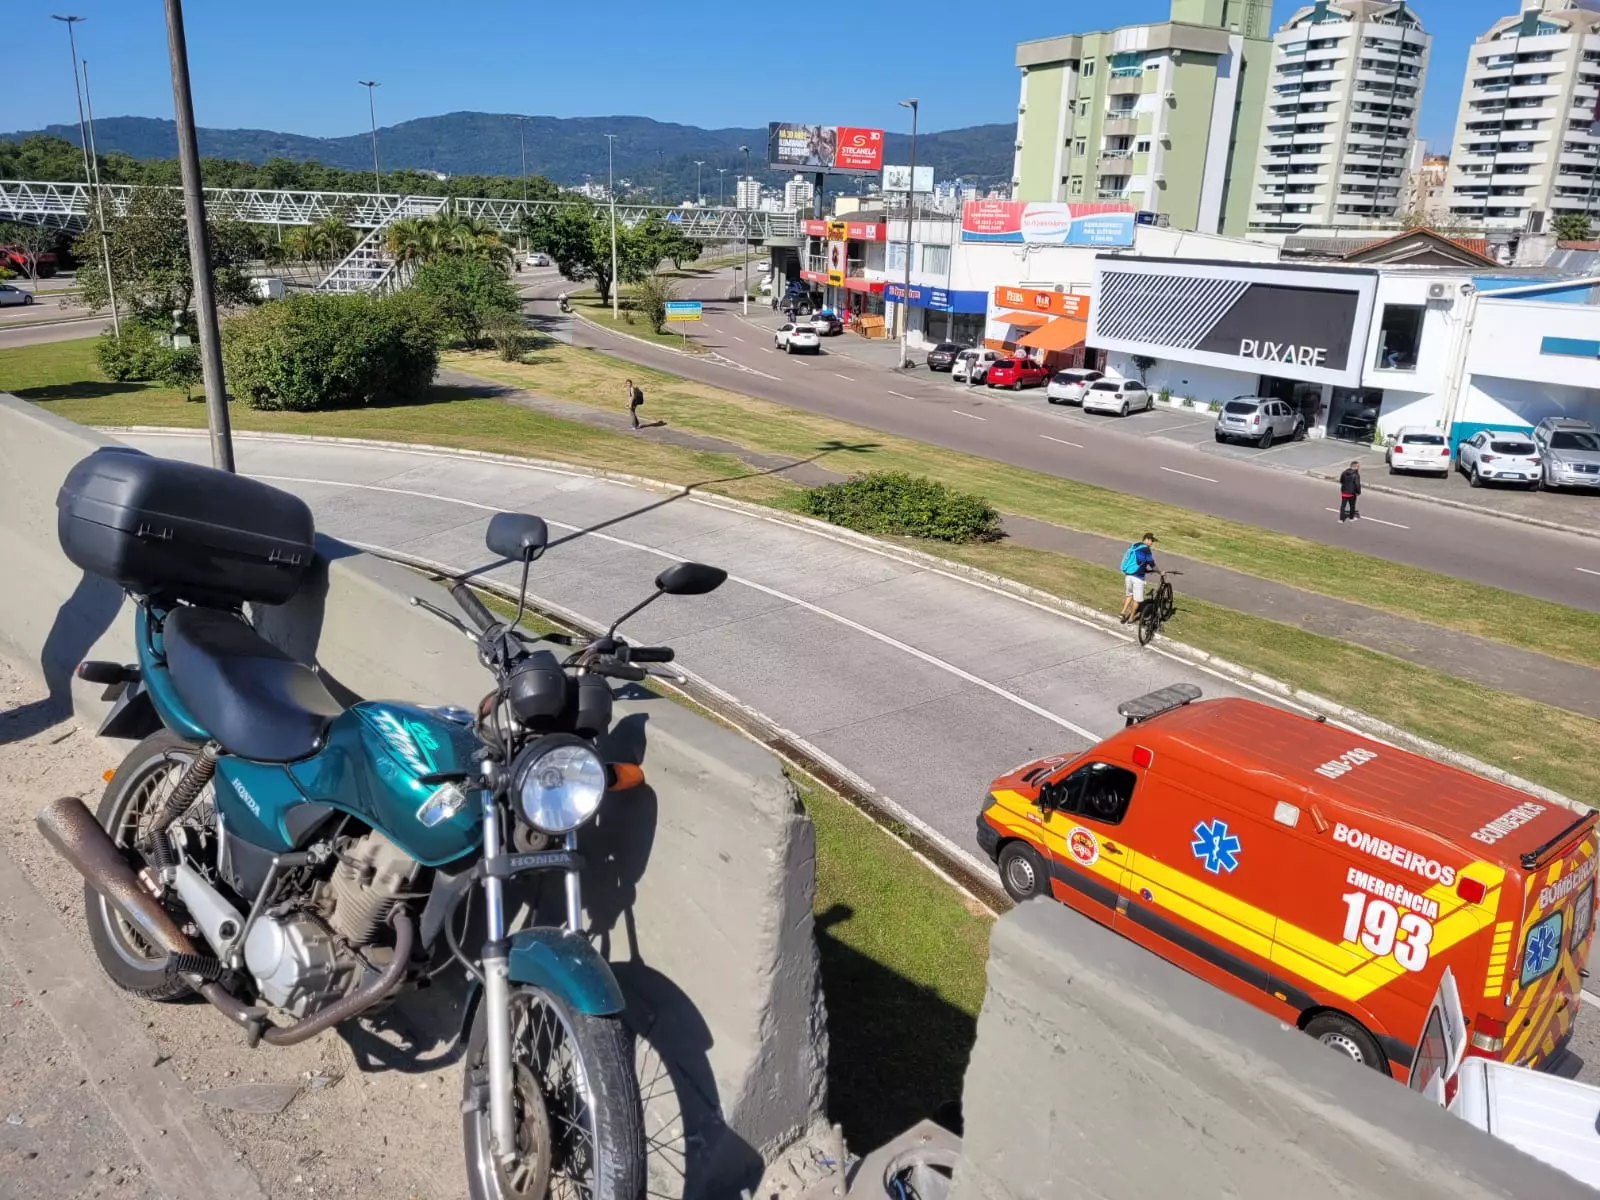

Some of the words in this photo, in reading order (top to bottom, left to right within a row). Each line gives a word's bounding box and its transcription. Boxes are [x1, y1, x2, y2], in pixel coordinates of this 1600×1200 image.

[1240, 338, 1328, 367] PUXARE
[231, 777, 261, 818] HONDA
[1470, 801, 1547, 845] BOMBEIROS
[510, 854, 573, 867] HONDA
[1333, 822, 1456, 887] BOMBEIROS
[1347, 867, 1440, 920] EMERGÊNCIA
[1342, 891, 1433, 973] 193
